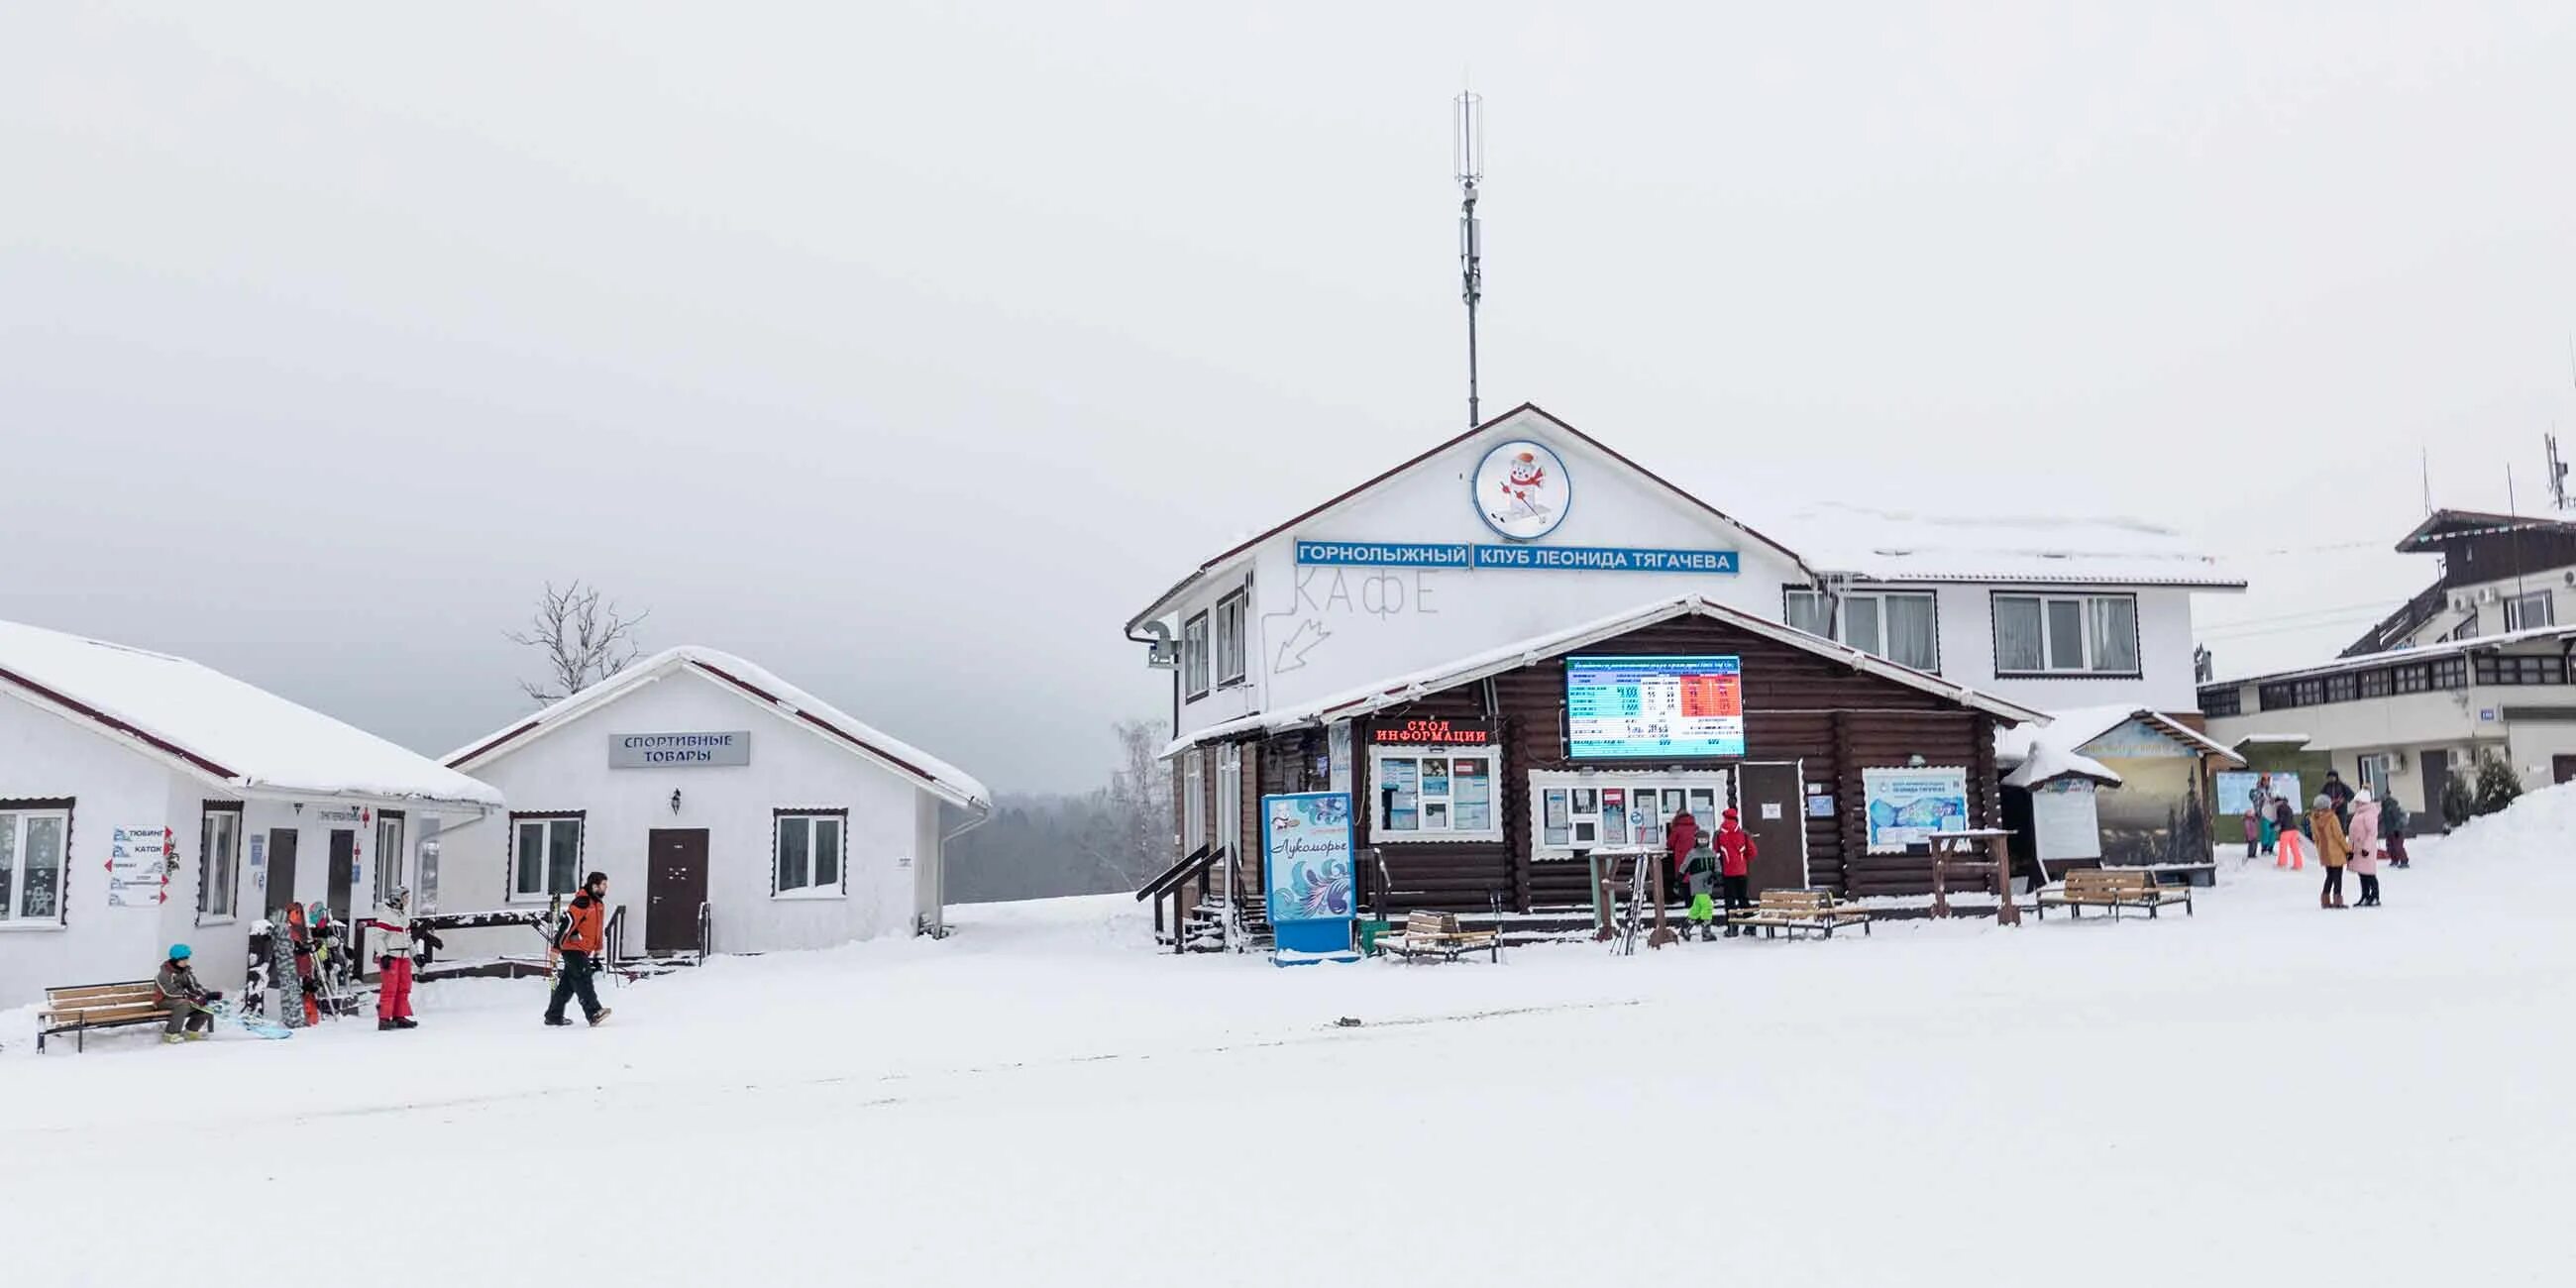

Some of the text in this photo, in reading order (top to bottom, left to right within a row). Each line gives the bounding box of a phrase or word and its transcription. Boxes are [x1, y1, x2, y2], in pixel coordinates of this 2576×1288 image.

[1299, 545, 1466, 564] ГОРНОЛЫЖНЫЙ
[1480, 550, 1730, 570] КЛУБ ЛЕОНИДА ТЯГАЧЕВА
[1296, 566, 1440, 620] КАФЕ
[1408, 720, 1449, 731] СТОЛ
[624, 735, 732, 748] СПОРТИВНЫЕ
[1375, 730, 1486, 742] ИНФОРМАЦИИ
[644, 750, 711, 762] ТОВАРЫ
[1271, 837, 1347, 859] Лукоморье
